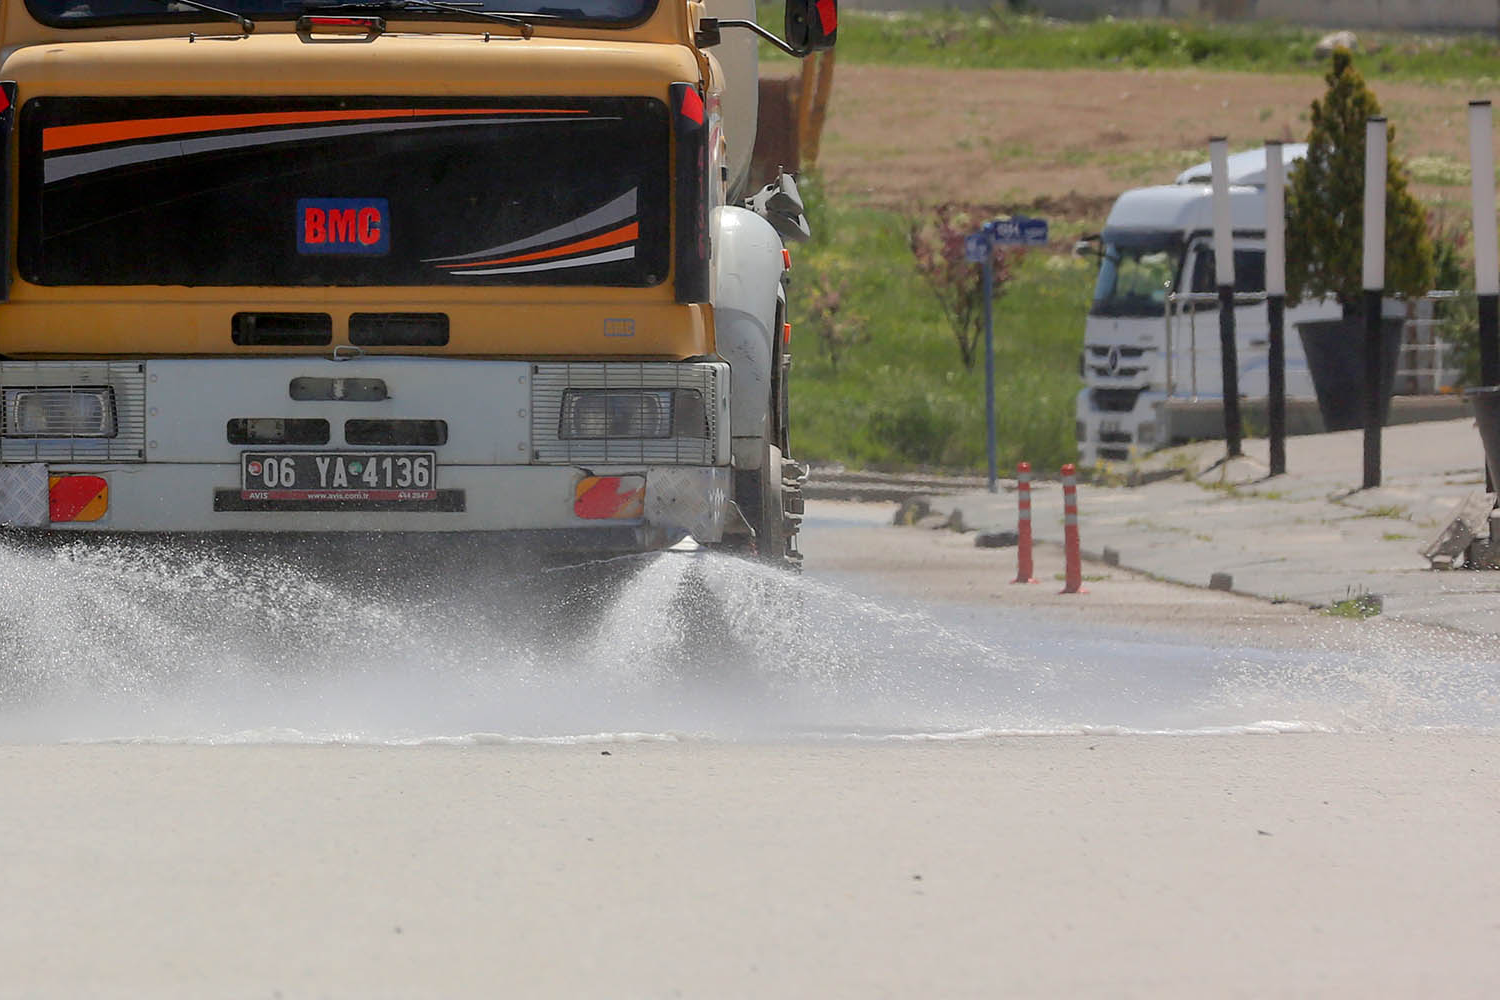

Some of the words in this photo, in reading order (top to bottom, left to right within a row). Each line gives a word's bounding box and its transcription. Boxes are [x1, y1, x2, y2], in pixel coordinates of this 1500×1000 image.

[304, 207, 381, 245] BMC
[263, 457, 296, 488] 06
[315, 457, 348, 488] YA
[362, 457, 429, 488] 4136
[307, 492, 370, 500] www.avis.com.tr
